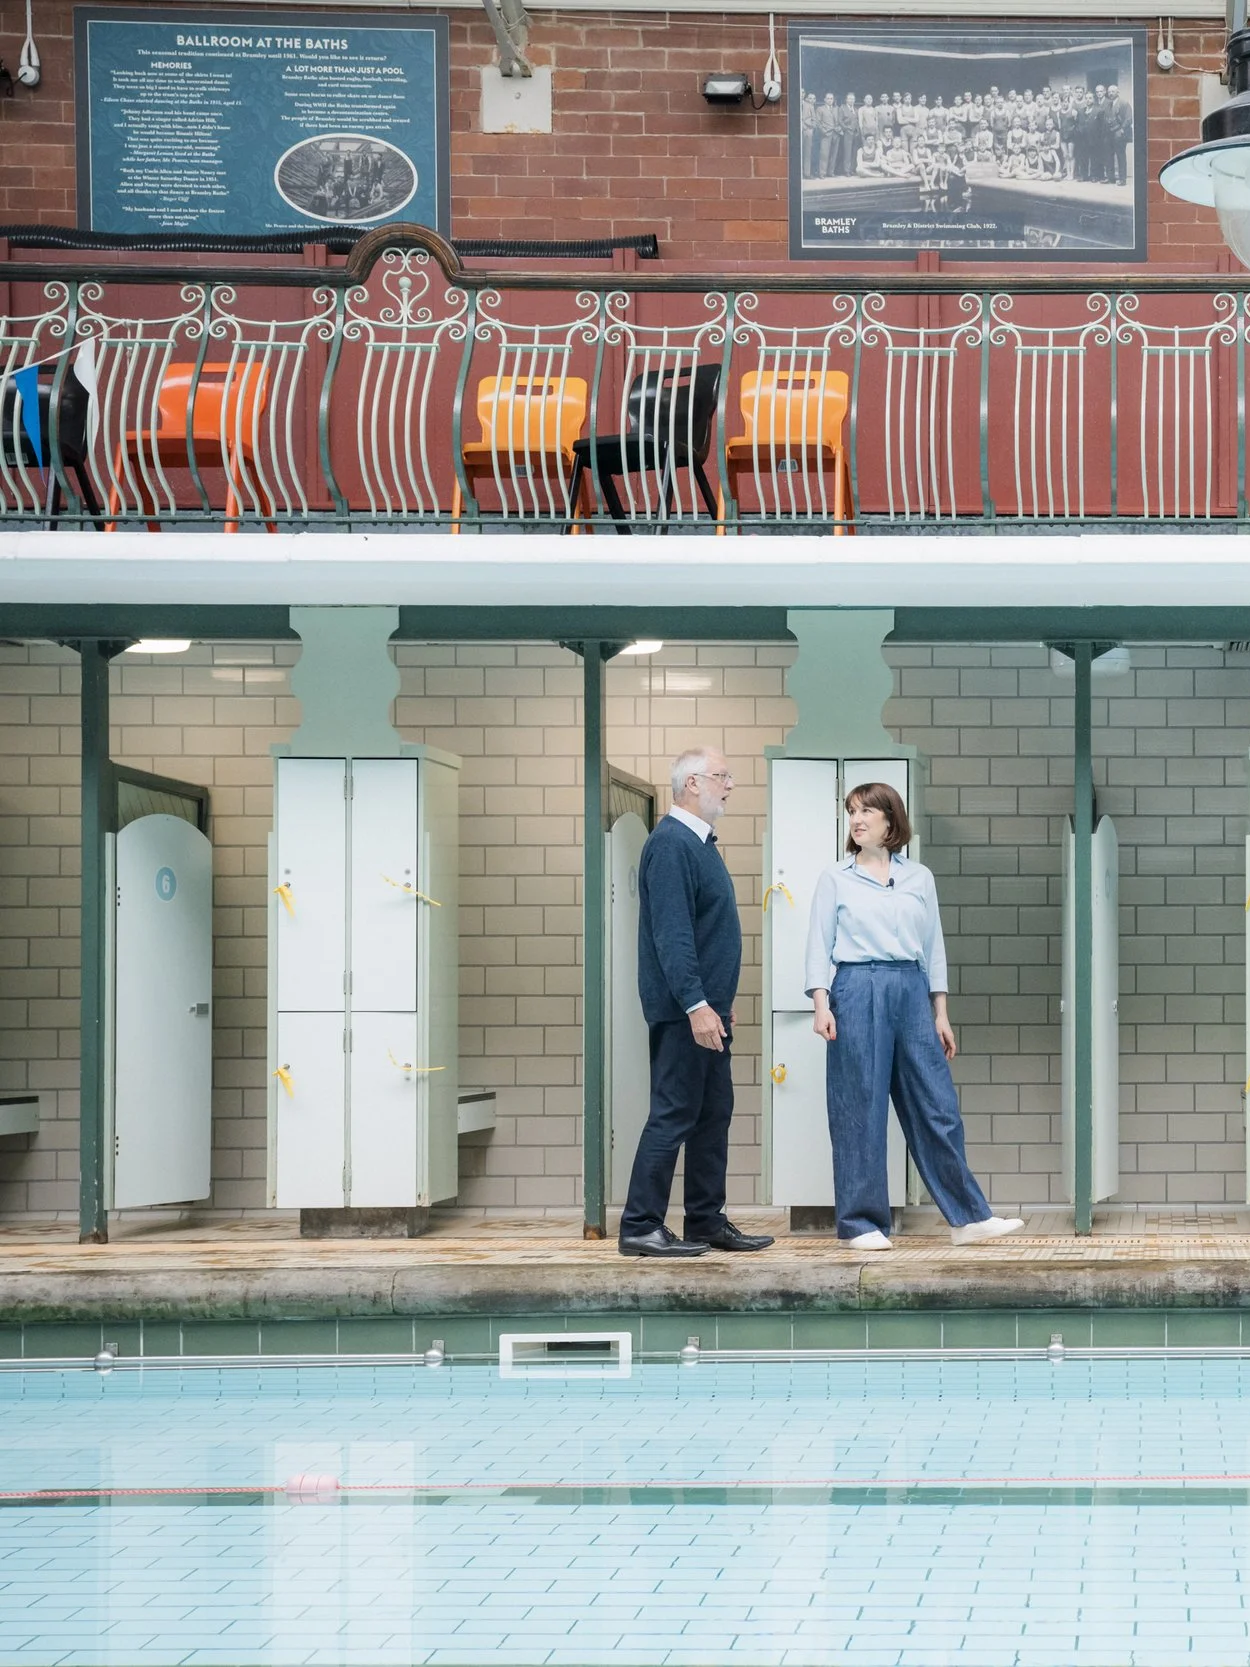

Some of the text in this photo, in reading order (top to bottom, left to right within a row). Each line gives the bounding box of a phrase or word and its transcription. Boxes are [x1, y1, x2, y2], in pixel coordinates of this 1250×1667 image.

[177, 36, 348, 50] BALLROOM AT THE BATHS
[162, 874, 170, 893] 6
